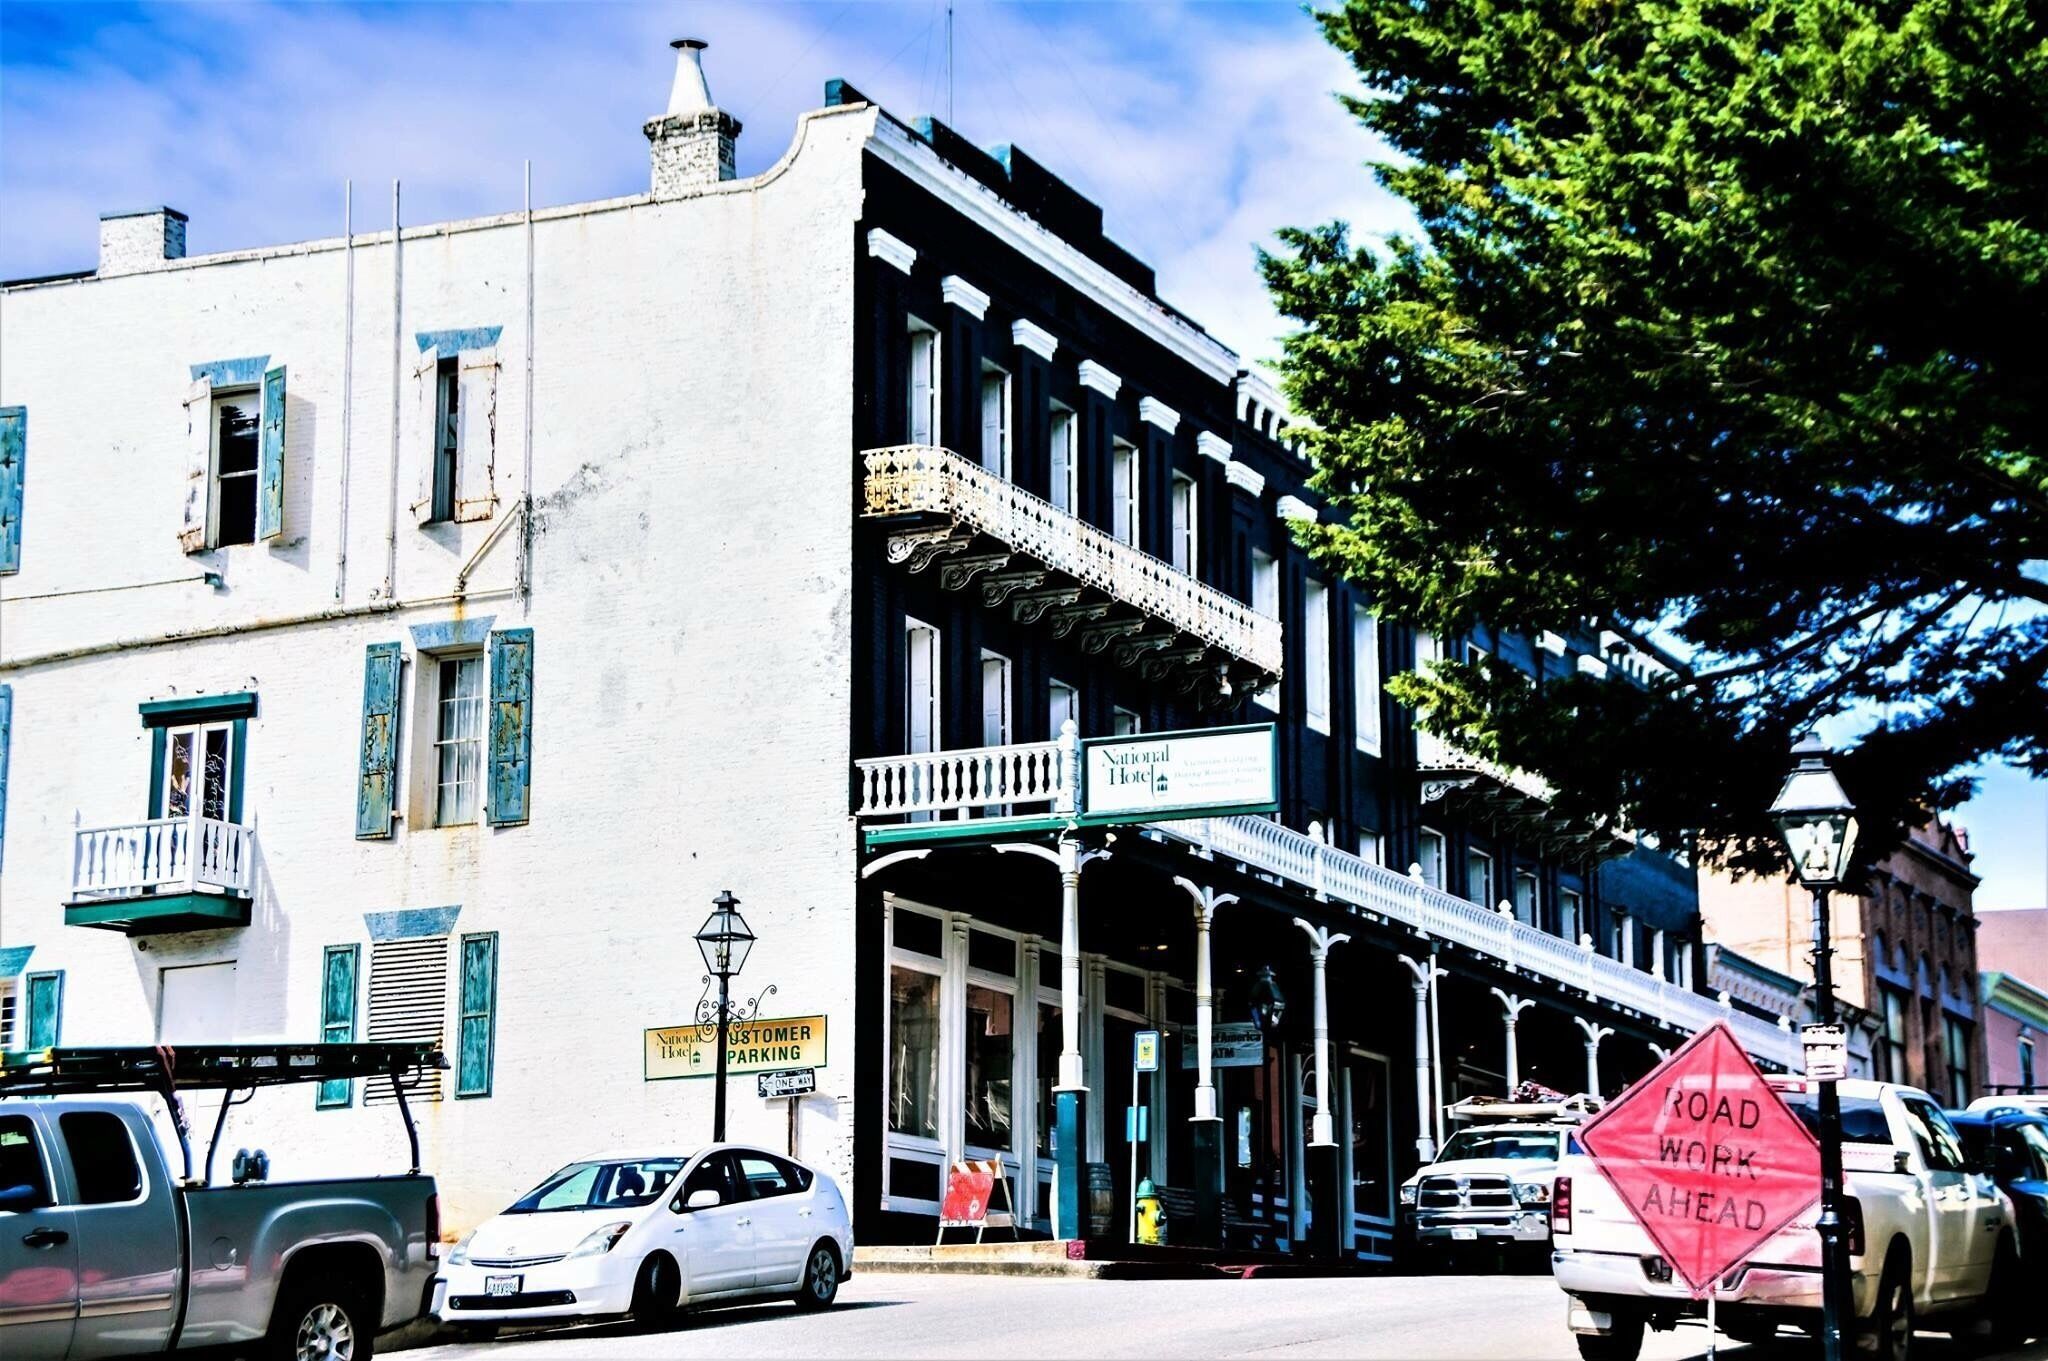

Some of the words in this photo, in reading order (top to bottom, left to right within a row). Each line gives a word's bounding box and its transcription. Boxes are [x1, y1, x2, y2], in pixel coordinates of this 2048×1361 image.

[1102, 744, 1170, 767] National
[1110, 765, 1154, 796] Hotel
[656, 1030, 702, 1046] National
[729, 1026, 811, 1045] USTOMER
[1221, 1031, 1261, 1044] America
[661, 1044, 692, 1066] Hotel
[727, 1045, 801, 1065] PARKING
[1212, 1047, 1235, 1059] ATM
[775, 1078, 794, 1090] ONE
[797, 1076, 812, 1086] WAY
[1664, 1086, 1760, 1129] ROAD
[1659, 1135, 1756, 1180] WORK
[1642, 1184, 1766, 1231] AHEAD
